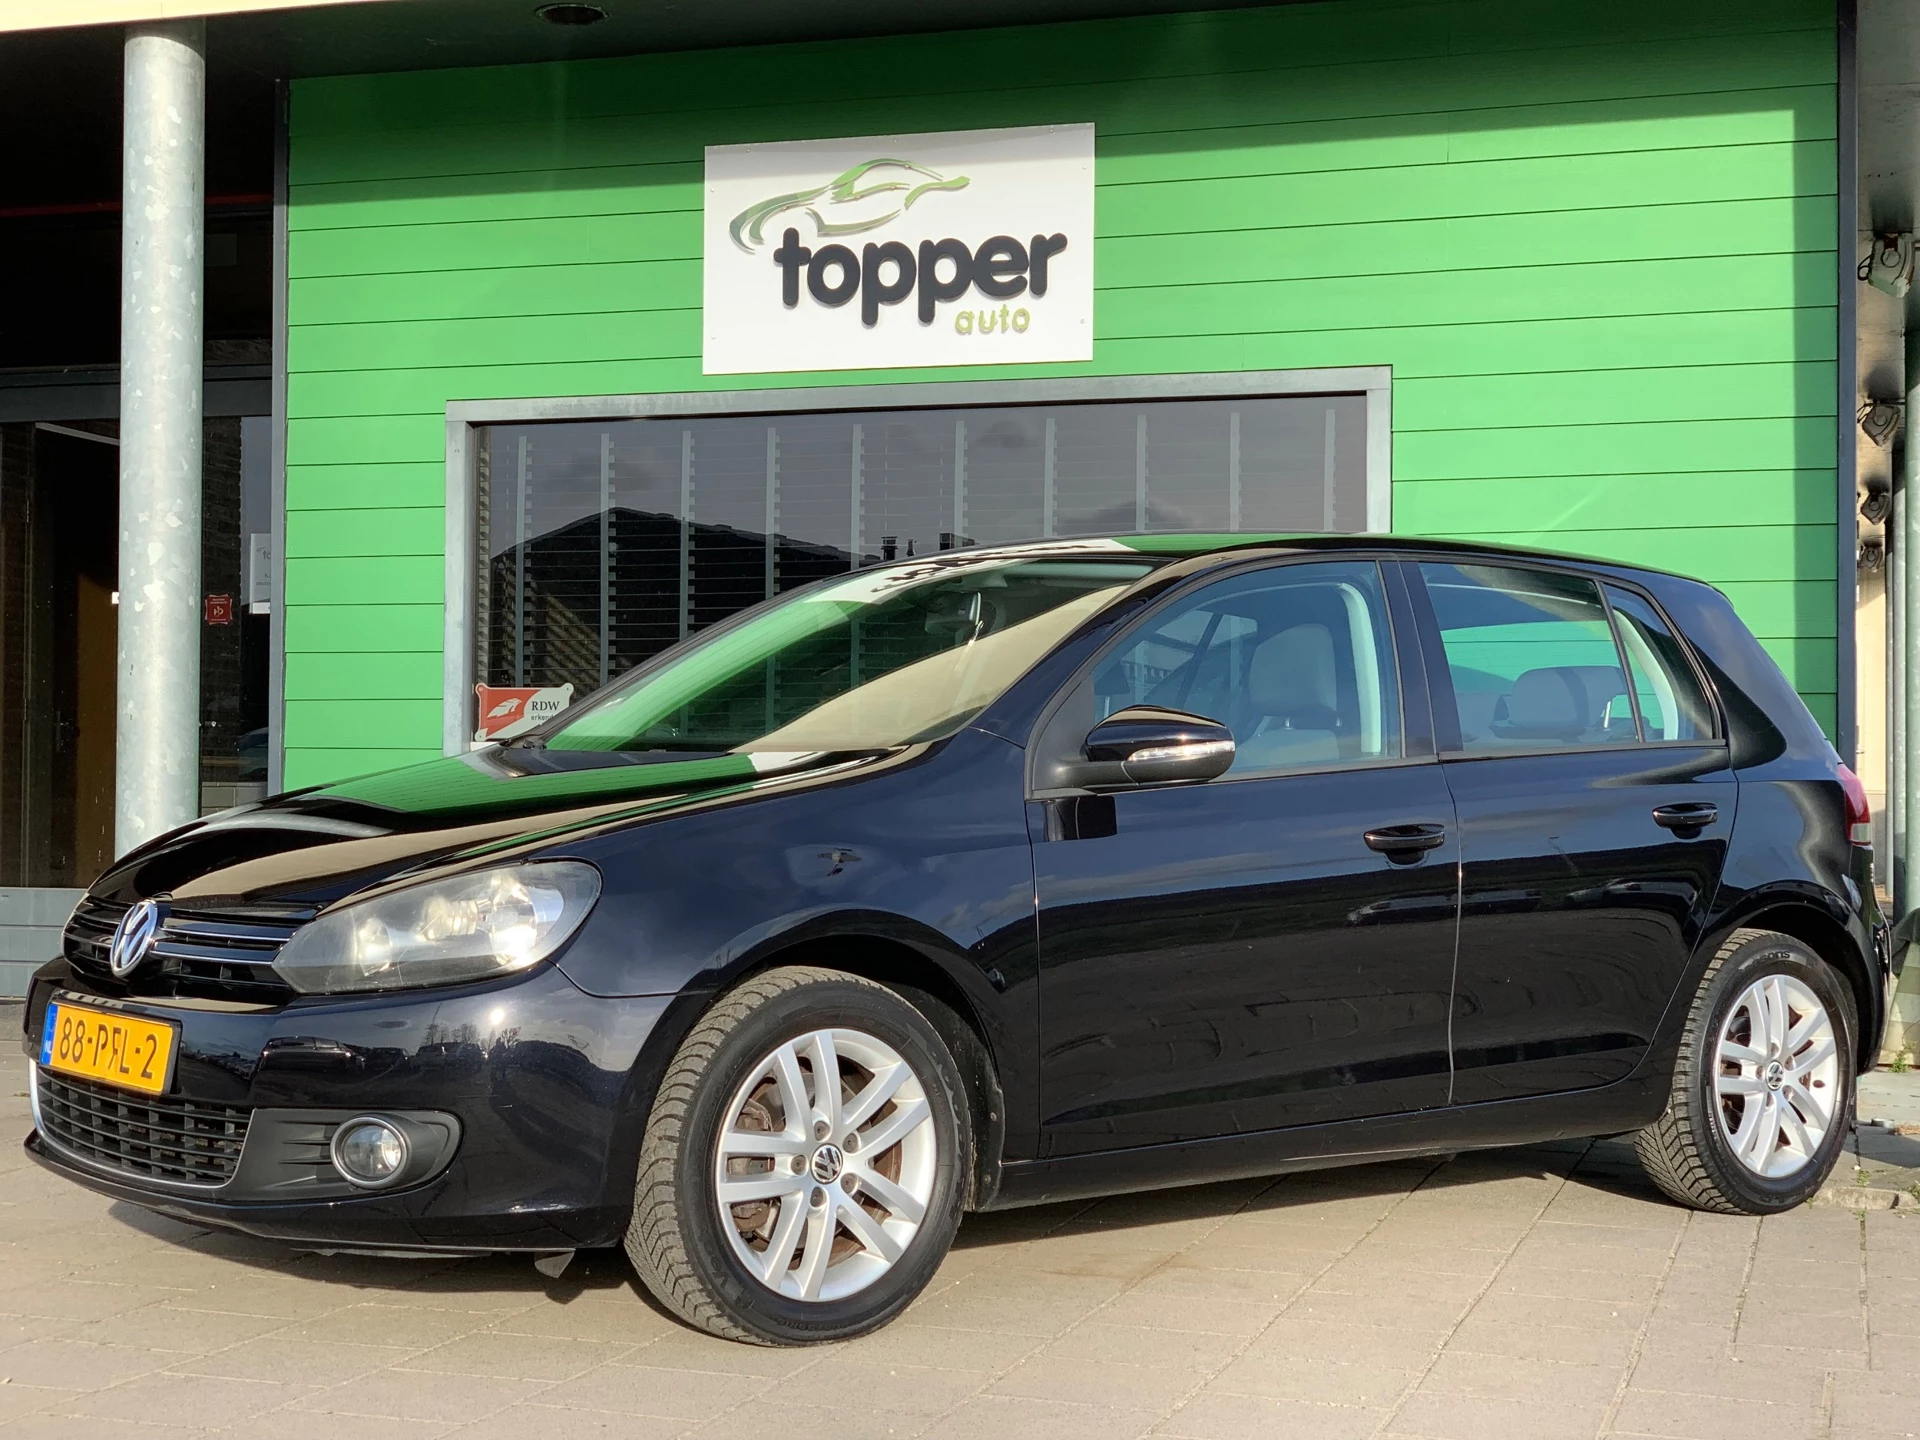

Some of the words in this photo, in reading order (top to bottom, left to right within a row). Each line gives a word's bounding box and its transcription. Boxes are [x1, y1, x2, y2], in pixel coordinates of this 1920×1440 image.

[773, 227, 1068, 326] topper
[954, 304, 1031, 334] auto
[531, 701, 560, 711] RDW
